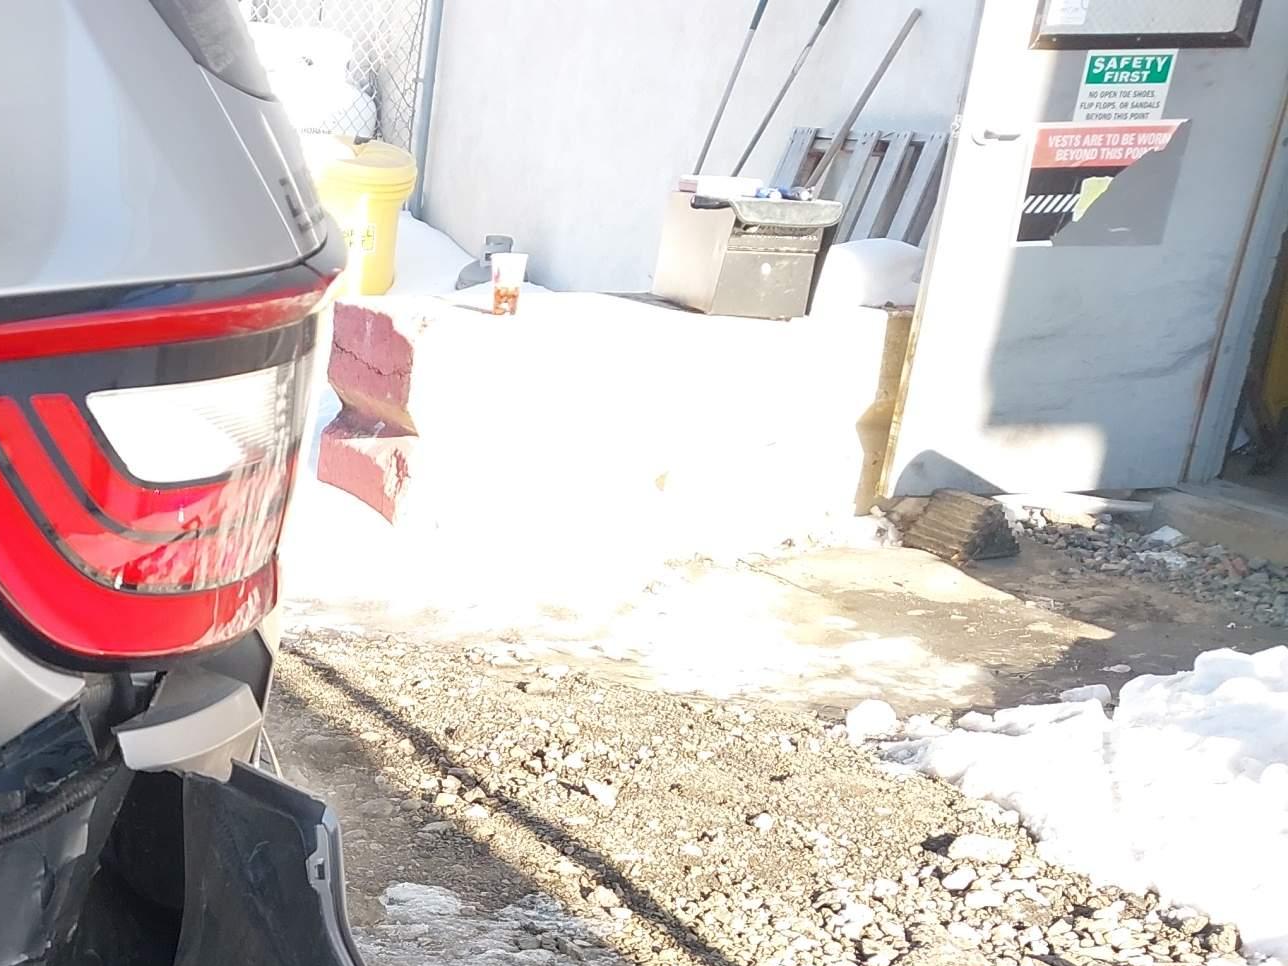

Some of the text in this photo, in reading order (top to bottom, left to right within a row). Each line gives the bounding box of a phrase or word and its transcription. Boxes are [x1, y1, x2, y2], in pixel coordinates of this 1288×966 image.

[1092, 56, 1169, 74] SAFETY
[1103, 71, 1151, 83] FIRST
[1088, 90, 1098, 98] NO
[1100, 90, 1117, 98] OPEN
[1119, 90, 1131, 98] TOE
[1080, 102, 1095, 110] FLIP
[1119, 101, 1129, 109] OR
[1130, 101, 1160, 109] SANDALS
[1086, 112, 1150, 120] BEYOND THIS POINT
[1048, 135, 1081, 148] VESTS
[1082, 134, 1104, 147] ARE
[1106, 134, 1120, 147] TO
[1121, 133, 1136, 146] BE
[1055, 149, 1098, 162] BEYOND
[1099, 147, 1123, 161] THIS
